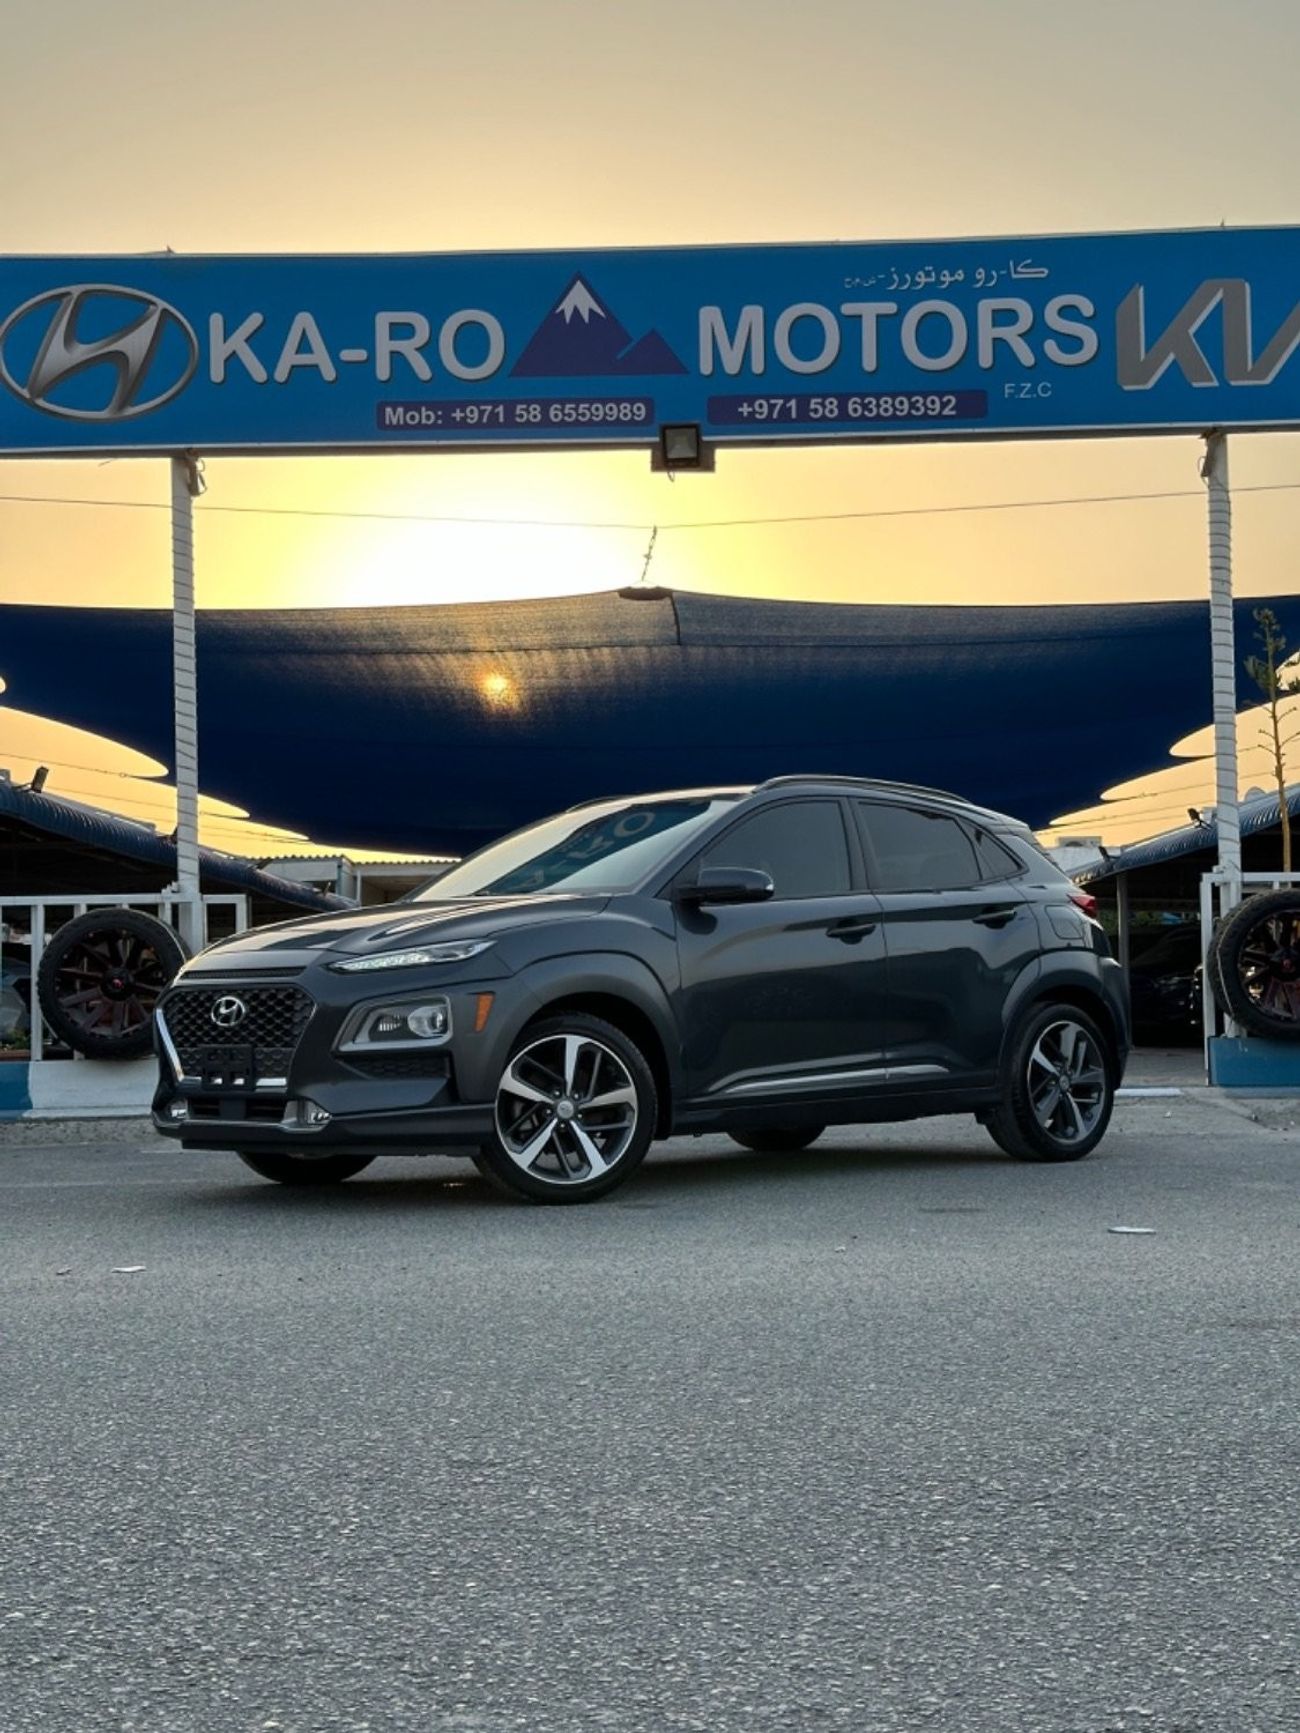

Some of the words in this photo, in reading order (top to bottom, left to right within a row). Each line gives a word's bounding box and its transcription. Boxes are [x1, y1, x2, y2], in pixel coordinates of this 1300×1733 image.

[209, 309, 505, 384] KA-RO
[698, 294, 1099, 376] MOTORS
[384, 406, 443, 426] Mob:
[451, 404, 505, 424] +971
[514, 404, 541, 423] 58
[549, 401, 647, 423] 6559989
[737, 398, 798, 419] +971
[808, 397, 839, 418] 58
[847, 395, 957, 417] 6389392
